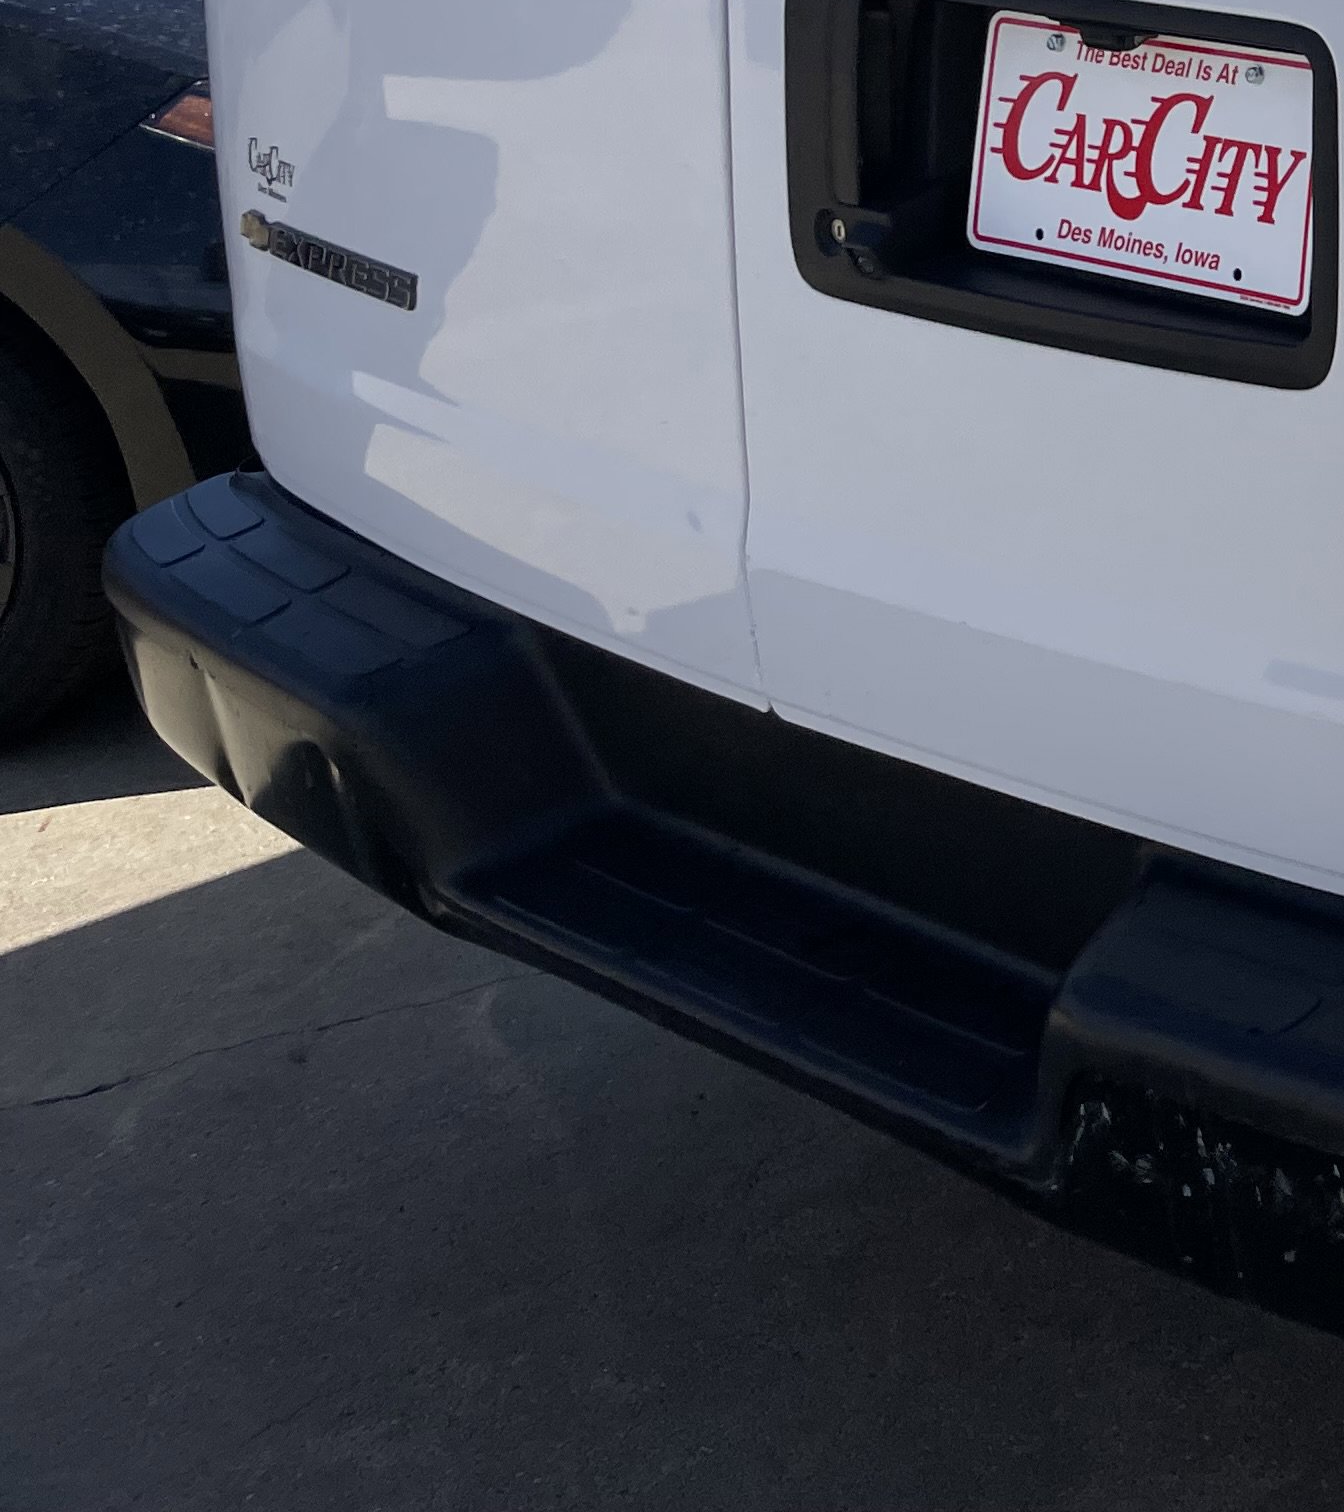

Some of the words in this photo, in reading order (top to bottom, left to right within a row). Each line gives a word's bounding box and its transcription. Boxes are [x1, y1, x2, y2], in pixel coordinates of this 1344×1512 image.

[1076, 40, 1105, 64] The
[1109, 50, 1148, 72] Best
[1151, 52, 1192, 78] Deal
[1196, 59, 1212, 81] Is
[1216, 63, 1239, 86] At
[1057, 218, 1092, 245] Des
[1097, 226, 1169, 264] Moines,
[1174, 242, 1221, 271] Iowa
